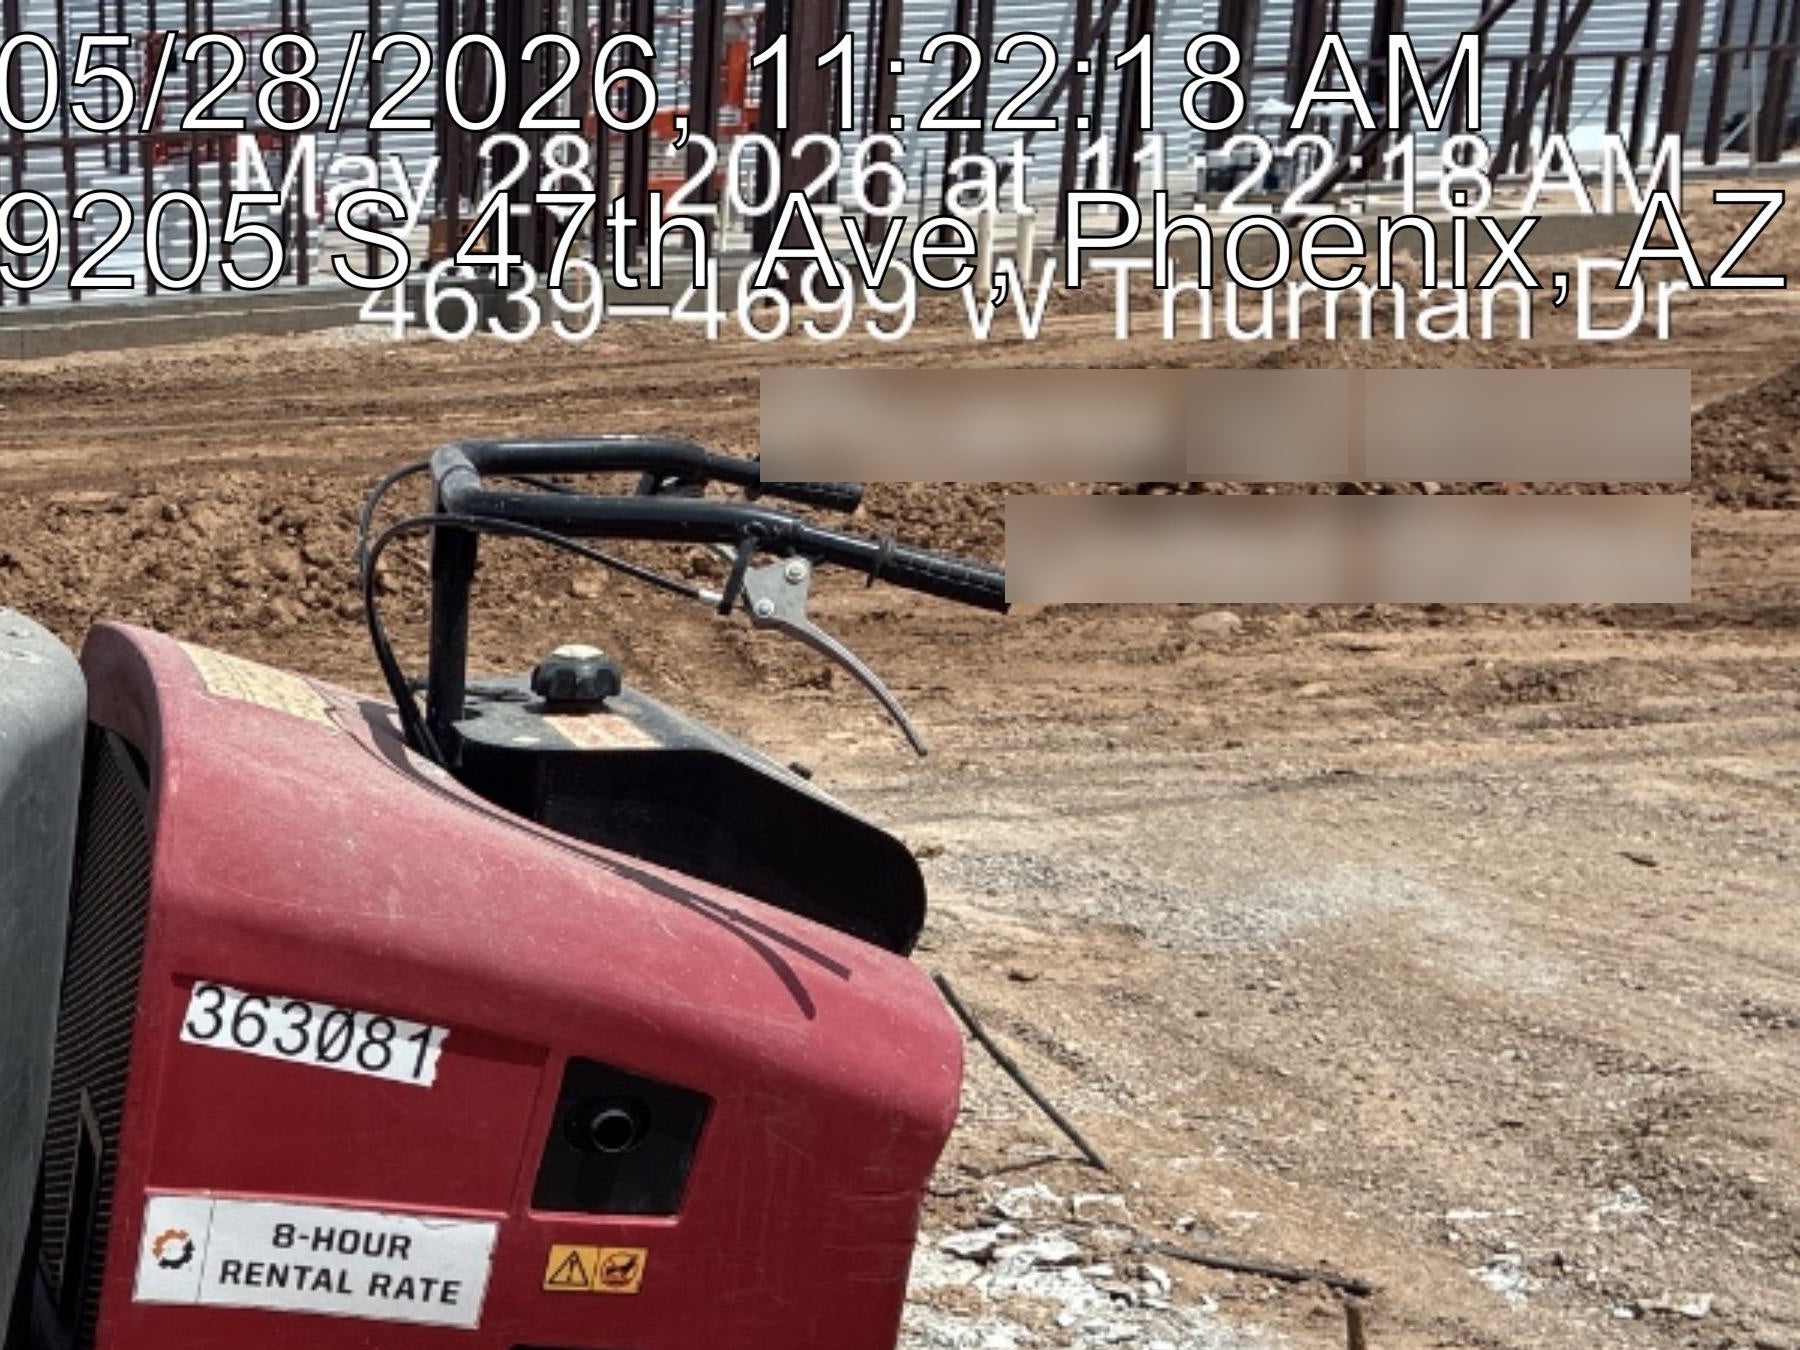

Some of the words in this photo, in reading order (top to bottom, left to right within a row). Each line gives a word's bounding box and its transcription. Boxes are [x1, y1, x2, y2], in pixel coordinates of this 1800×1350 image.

[186, 985, 437, 1079] 363081
[272, 1222, 412, 1261] 8-HOUR
[219, 1259, 352, 1295] RENTAL
[368, 1271, 462, 1305] RATE
